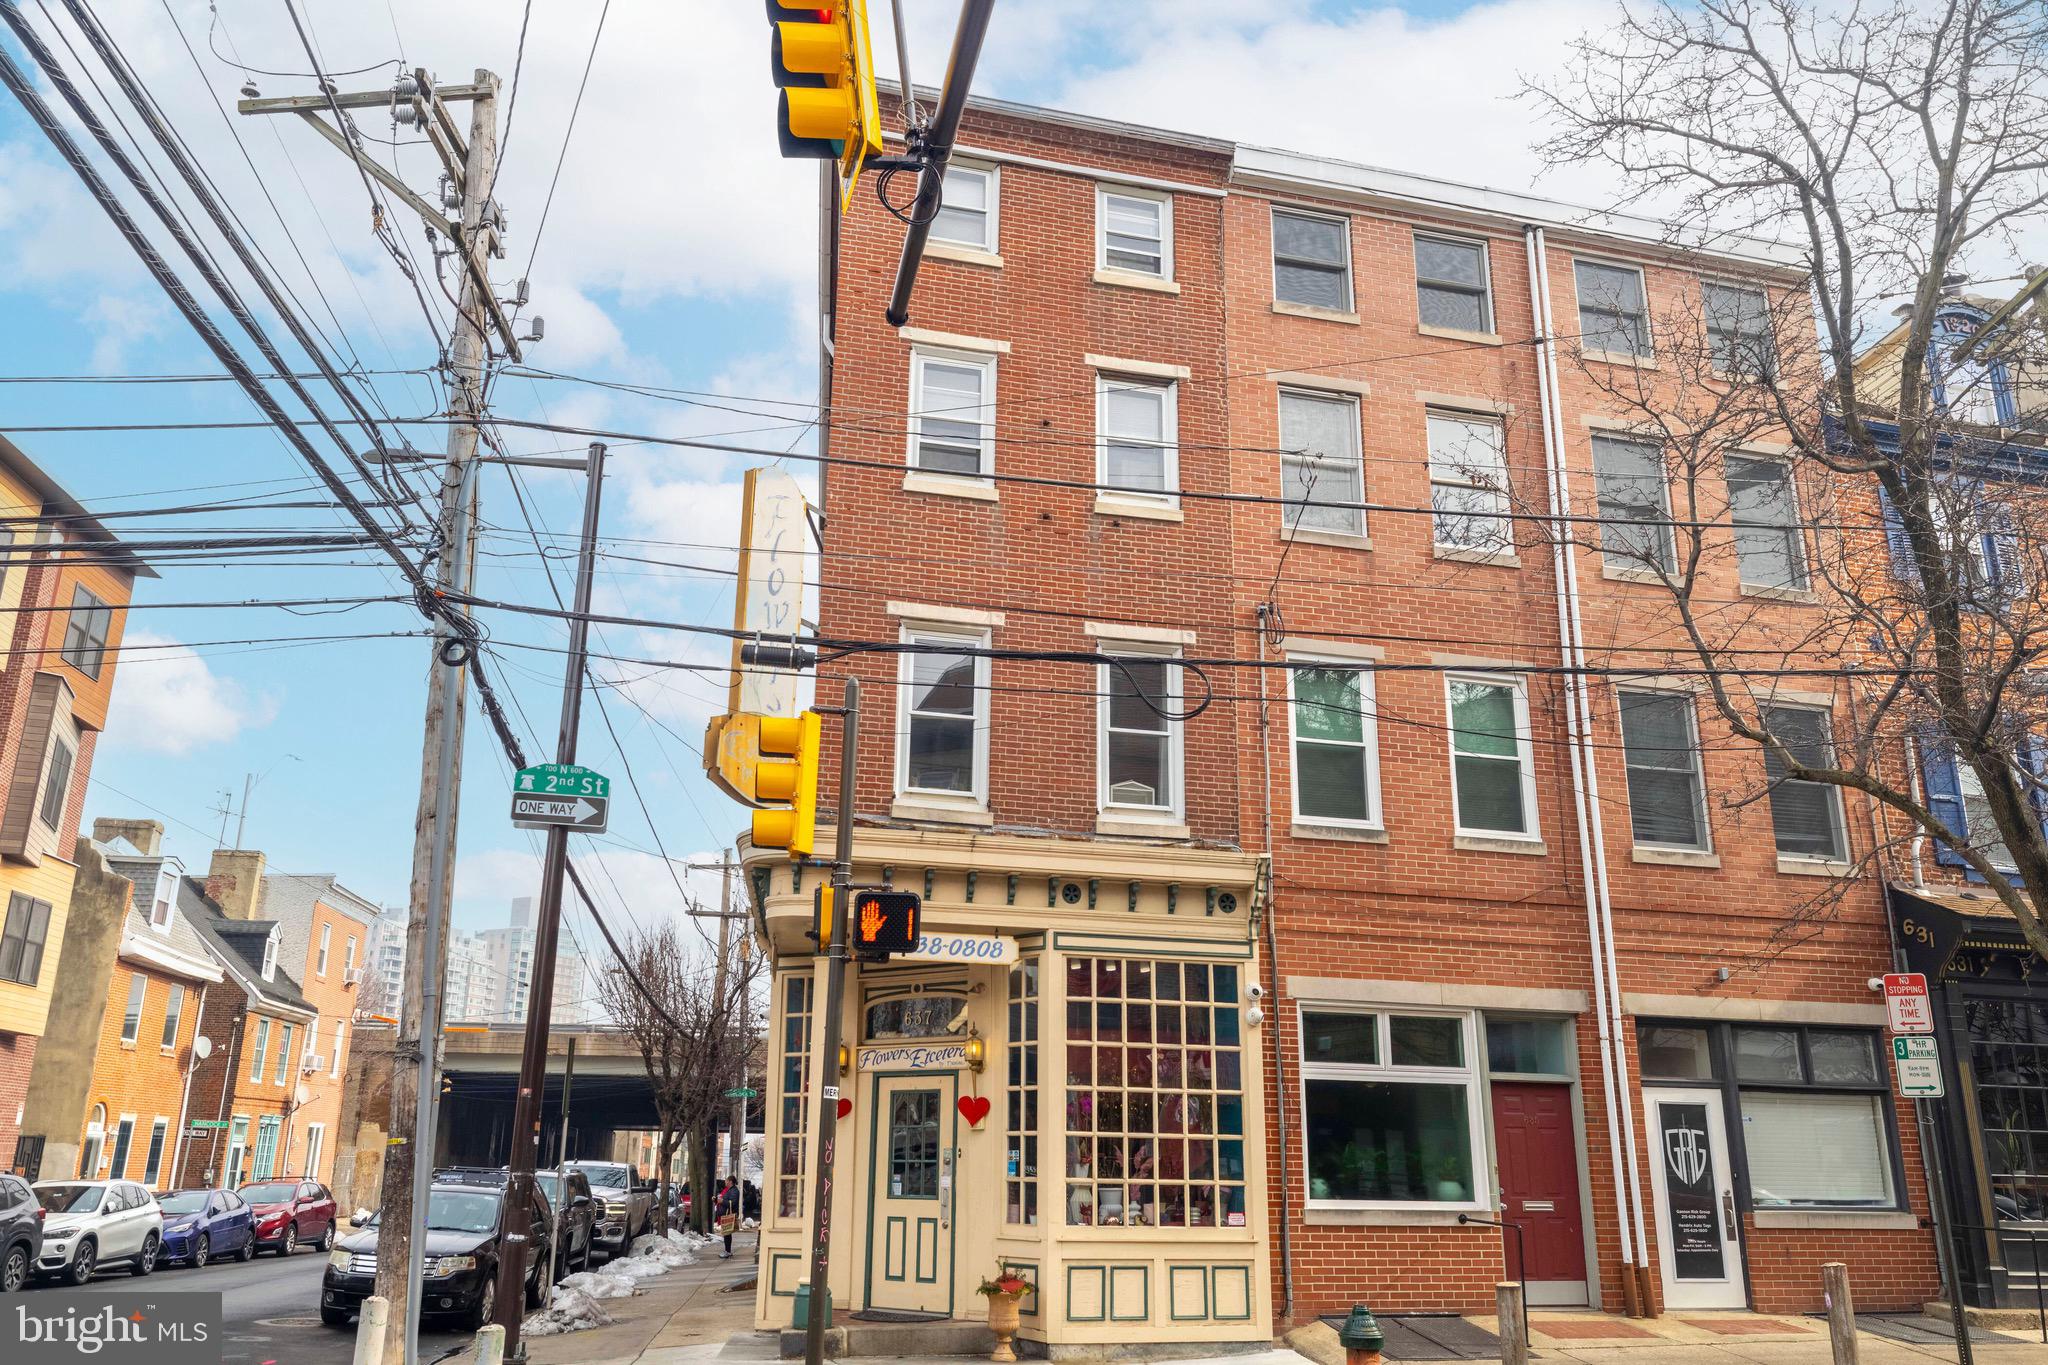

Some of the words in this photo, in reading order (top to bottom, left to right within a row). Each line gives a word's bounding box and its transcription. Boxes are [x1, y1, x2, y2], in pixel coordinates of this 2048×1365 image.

[560, 766, 568, 774] N
[545, 775, 574, 792] 2nd
[581, 777, 604, 795] St
[520, 801, 544, 813] ONE
[550, 803, 575, 815] WAY
[1903, 919, 1935, 948] 631
[1899, 976, 1909, 984] NO
[1888, 985, 1923, 994] STOPPING
[1899, 998, 1916, 1007] ANY
[904, 1010, 933, 1025] 637
[1899, 1009, 1920, 1018] TIME
[1897, 1041, 1905, 1056] 3
[1915, 1040, 1927, 1048] HR
[859, 1048, 910, 1069] Flowers
